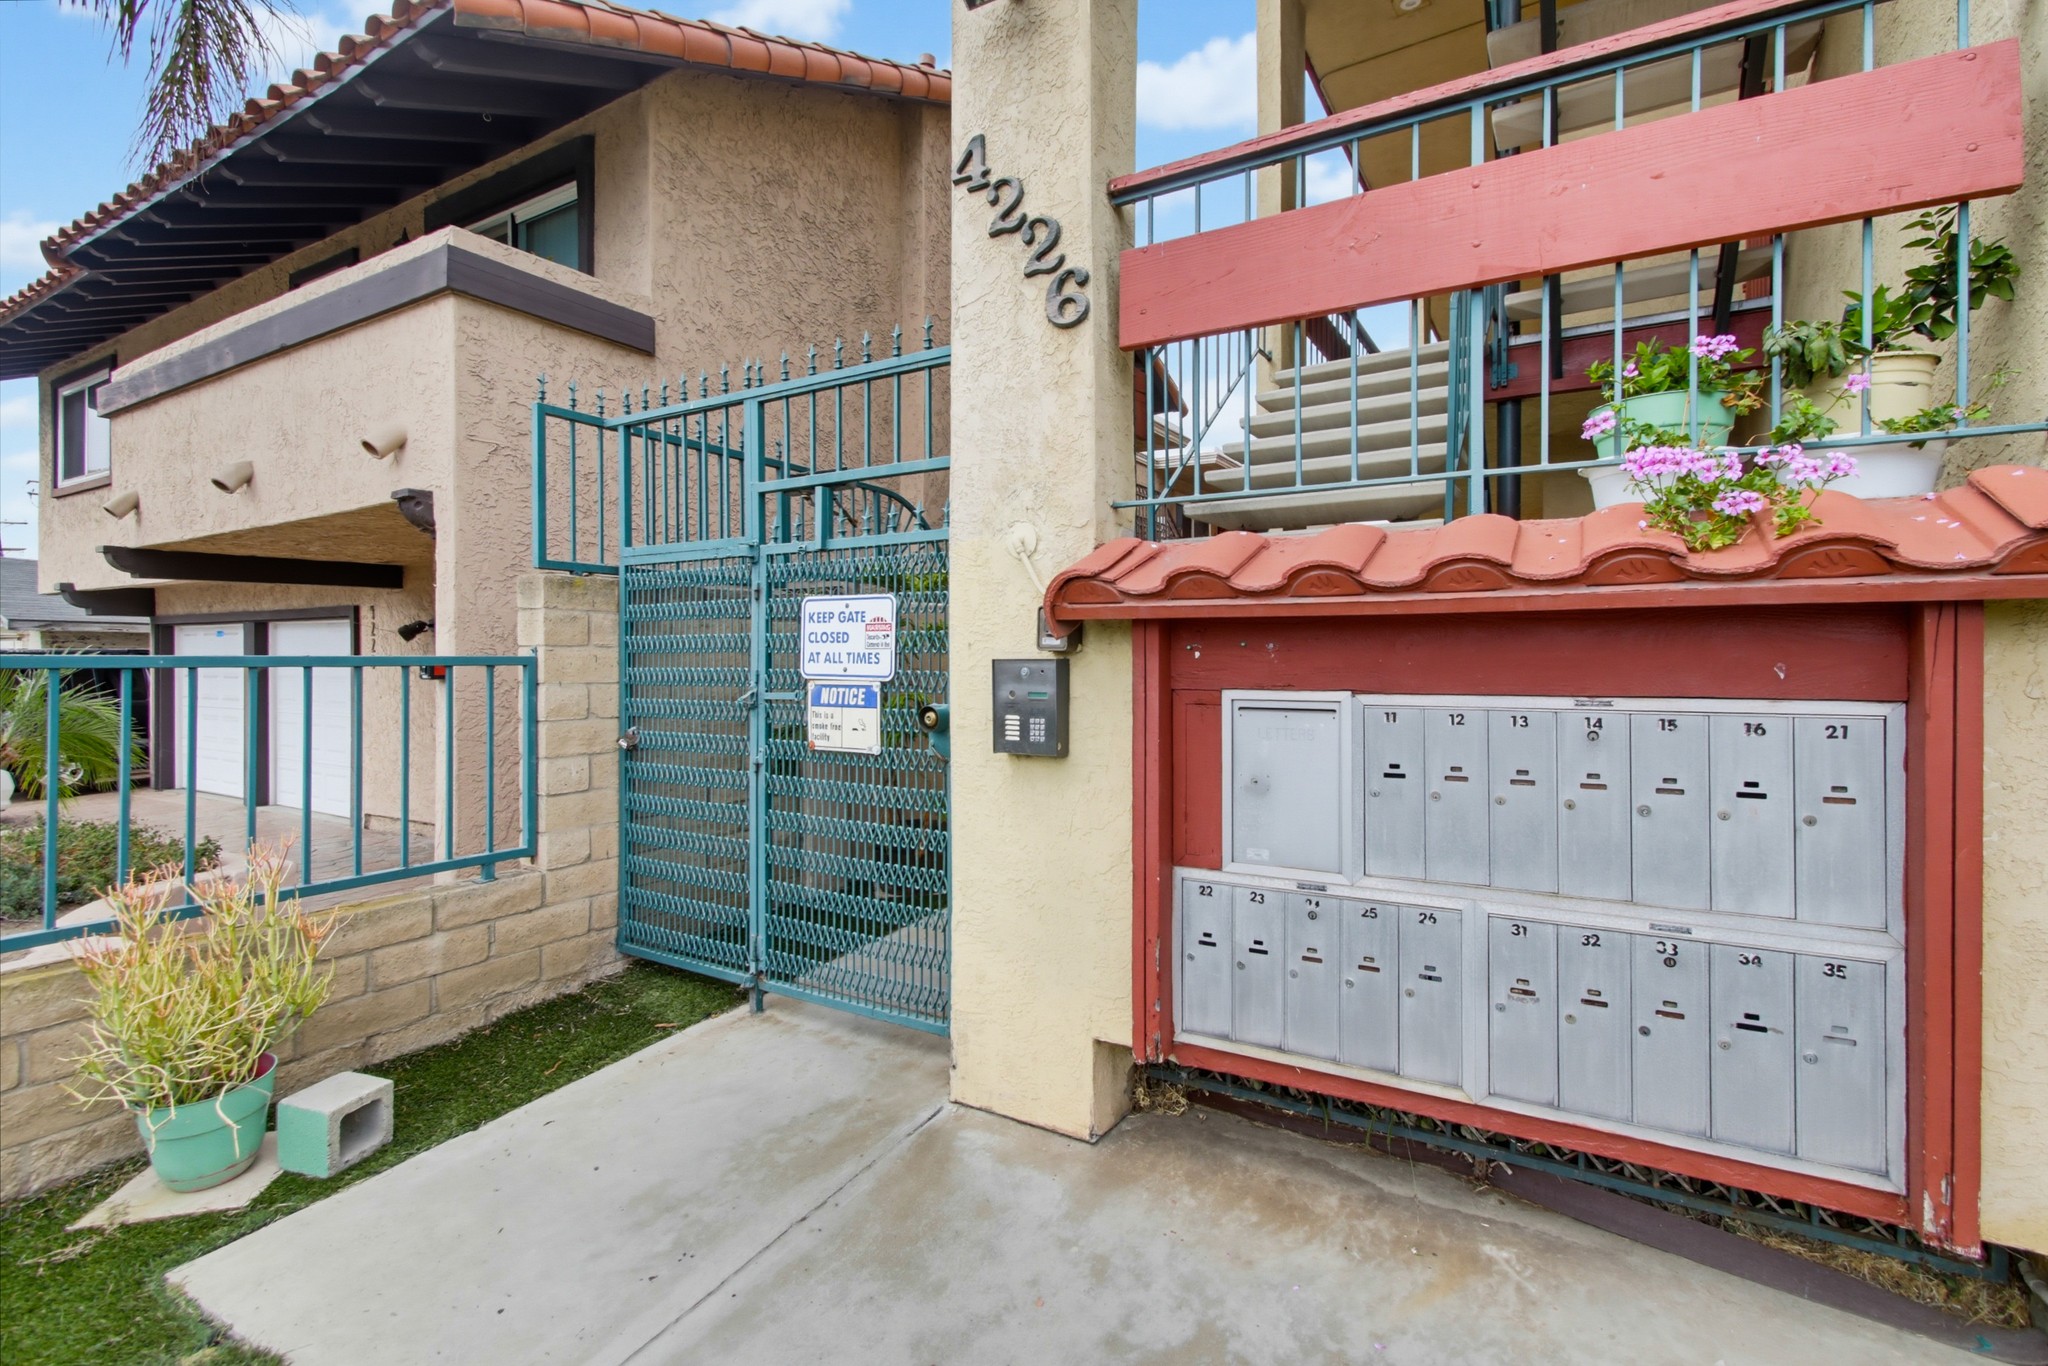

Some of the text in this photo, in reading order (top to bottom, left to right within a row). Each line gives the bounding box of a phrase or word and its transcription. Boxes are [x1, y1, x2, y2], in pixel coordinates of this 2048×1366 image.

[952, 133, 1091, 329] 4226
[808, 610, 866, 624] KEEP GATE
[808, 632, 849, 644] CLOSED
[808, 652, 880, 664] AT ALL TIMES
[820, 687, 866, 705] NOTICE
[812, 711, 823, 719] This
[1384, 711, 1397, 723] 11
[1449, 713, 1465, 726] 12
[1511, 715, 1529, 728] 13
[830, 722, 842, 730] free
[1585, 717, 1603, 730] 14
[1658, 719, 1678, 732] 15
[1743, 723, 1766, 736] 16
[812, 732, 830, 742] facility
[1825, 725, 1848, 739] 21
[1199, 885, 1213, 897] 22
[1250, 891, 1265, 904] 23
[1361, 907, 1378, 919] 25
[1511, 923, 1528, 937] 31
[1581, 934, 1601, 947] 32
[1656, 941, 1678, 956] 33
[1739, 953, 1763, 967] 34
[1823, 963, 1847, 979] 35
